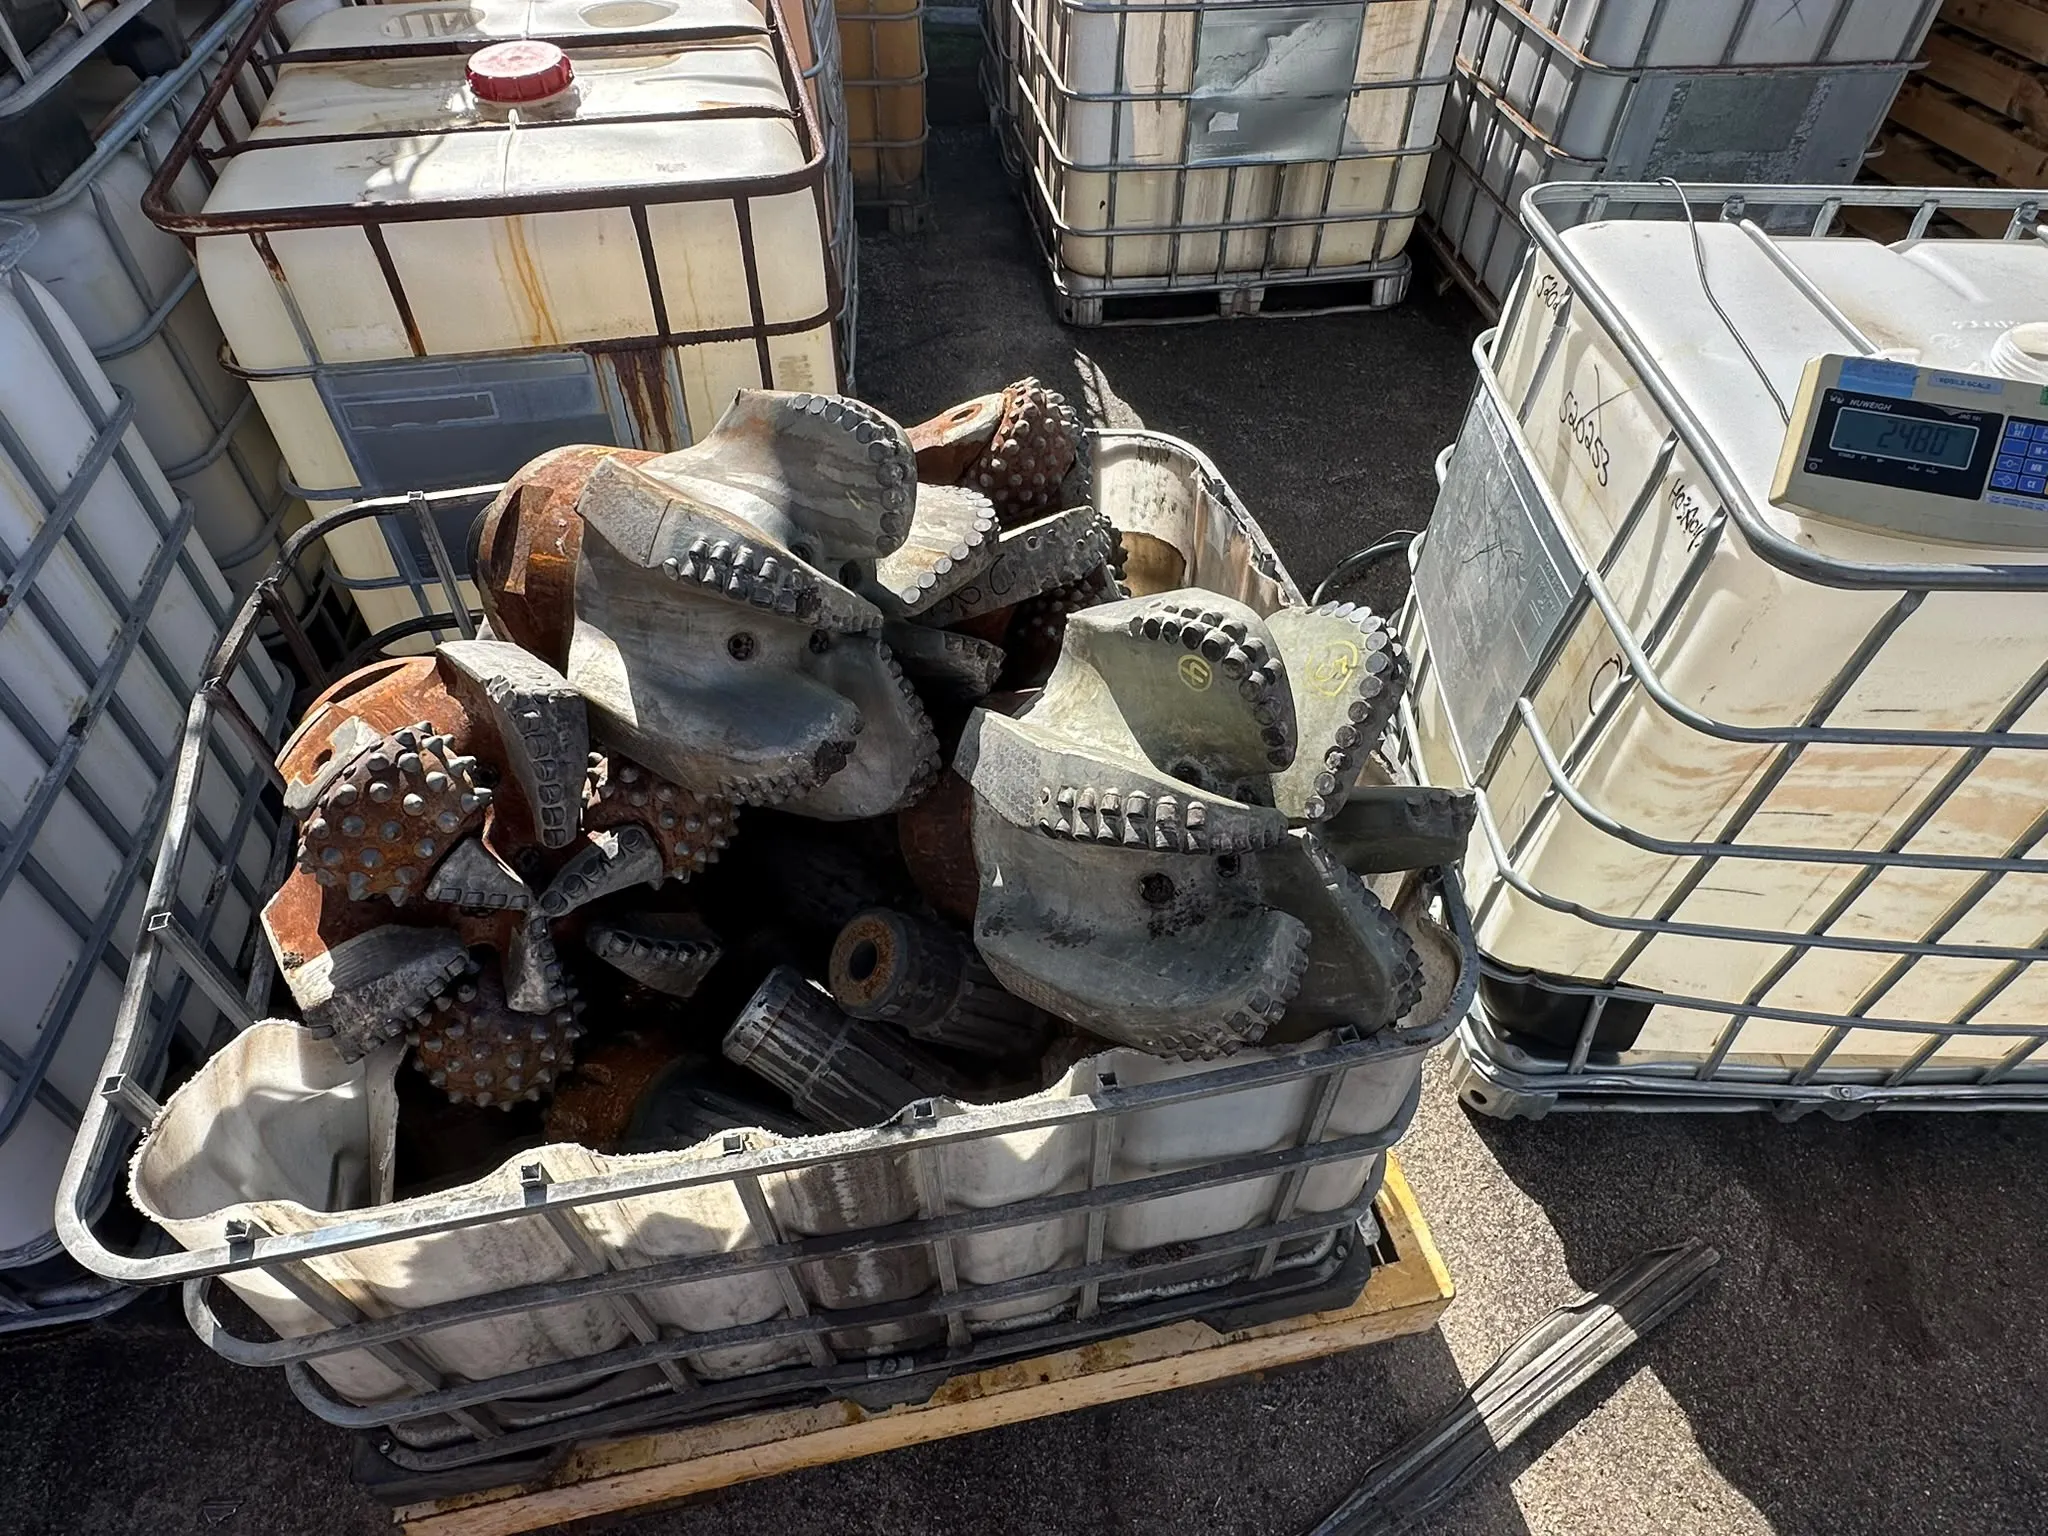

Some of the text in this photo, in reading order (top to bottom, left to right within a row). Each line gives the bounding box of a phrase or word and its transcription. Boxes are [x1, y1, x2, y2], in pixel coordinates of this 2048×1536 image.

[1849, 399, 1892, 411] NUWEIGH
[1559, 390, 1610, 487] 520253
[1876, 419, 1949, 456] 2480
